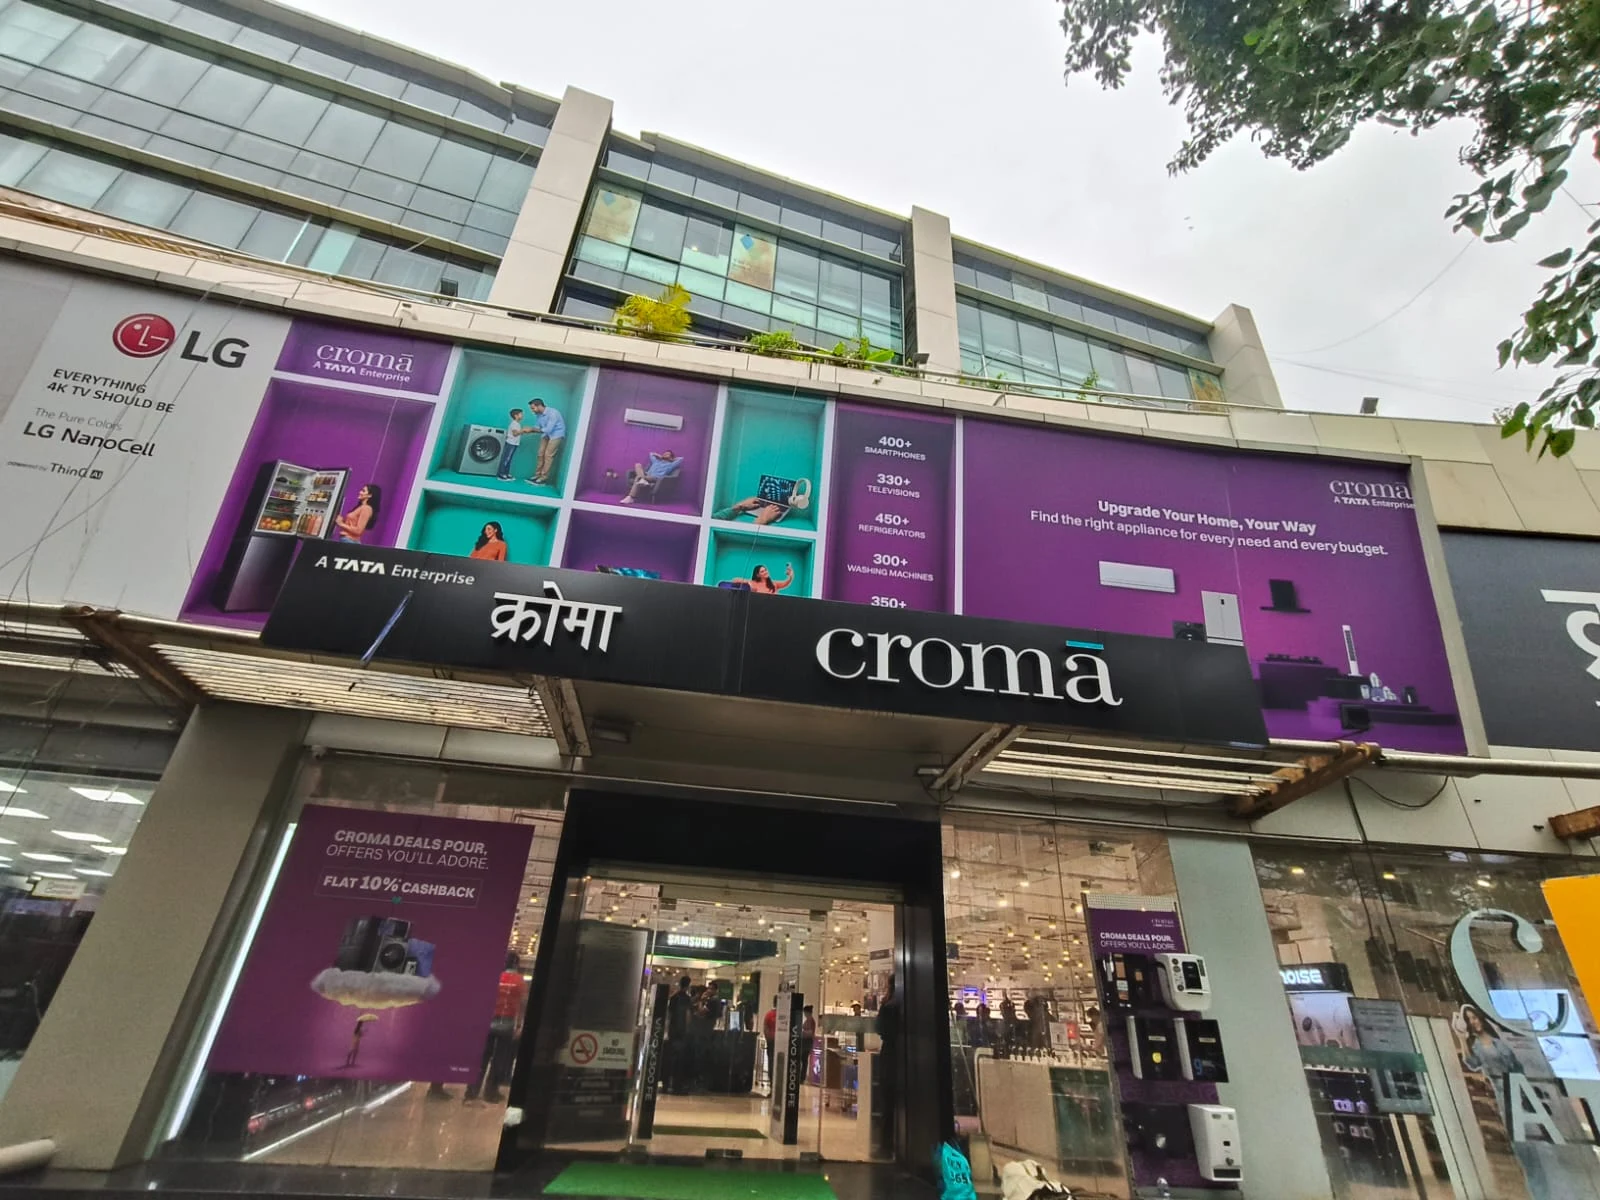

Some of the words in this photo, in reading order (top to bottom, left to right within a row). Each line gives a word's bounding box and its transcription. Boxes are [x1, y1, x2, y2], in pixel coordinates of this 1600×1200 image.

[180, 330, 250, 368] LG
[312, 361, 321, 369] A
[324, 362, 356, 374] TATA
[360, 367, 411, 382] Enterprise
[53, 368, 147, 394] EVERYTHING
[47, 382, 66, 393] 4K
[72, 386, 91, 397] TV
[93, 390, 153, 409] SHOULD
[156, 401, 176, 413] BE
[35, 407, 56, 419] The
[58, 411, 85, 425] Pure
[87, 417, 123, 431] Colors
[23, 421, 56, 439] LG
[61, 428, 156, 457] NanoCell
[878, 436, 913, 448] 400+
[864, 446, 926, 461] SMARTPHONES
[50, 462, 88, 478] ThinQ
[876, 473, 911, 486] 330+
[867, 485, 921, 498] TELEVISIONS
[1334, 496, 1341, 504] A
[1341, 497, 1370, 506] TATA
[875, 513, 910, 525] 450+
[1098, 500, 1161, 519] Upgrade
[1162, 508, 1195, 522] Your
[1197, 513, 1243, 531] Home,
[1244, 517, 1280, 531] Your
[1282, 520, 1317, 536] Way
[858, 524, 926, 539] REFRIGERATORS
[1030, 510, 1059, 524] Find
[1061, 514, 1082, 526] the
[1085, 516, 1115, 532] right
[1117, 522, 1178, 538] appliance
[1180, 528, 1197, 540] for
[1199, 533, 1235, 548] every
[1237, 536, 1271, 548] need
[1273, 539, 1299, 550] and
[1300, 541, 1338, 554] every
[1339, 541, 1389, 557] budget.
[872, 553, 908, 567] 300+
[314, 555, 328, 569] A
[333, 556, 386, 576] TATA
[391, 564, 475, 586] Enterprise
[847, 564, 888, 577] WASHING
[889, 568, 934, 582] MACHINES
[870, 595, 907, 609] 350+
[490, 580, 623, 652] क्रोमा
[334, 829, 391, 846] CROMA
[393, 835, 442, 850] DEALS
[443, 839, 489, 855] POUR,
[326, 844, 383, 861] OFFERS
[386, 849, 434, 865] YOU'LL
[436, 854, 489, 870] ADORE.
[323, 875, 359, 889] FLAT
[401, 881, 476, 899] CASHBACK
[1099, 931, 1127, 940] CROMA
[1127, 933, 1151, 941] DEALS
[1100, 940, 1127, 949] OFFERS
[788, 1059, 799, 1091] X300
[644, 1086, 653, 1101] FE
[787, 1093, 797, 1109] FE
